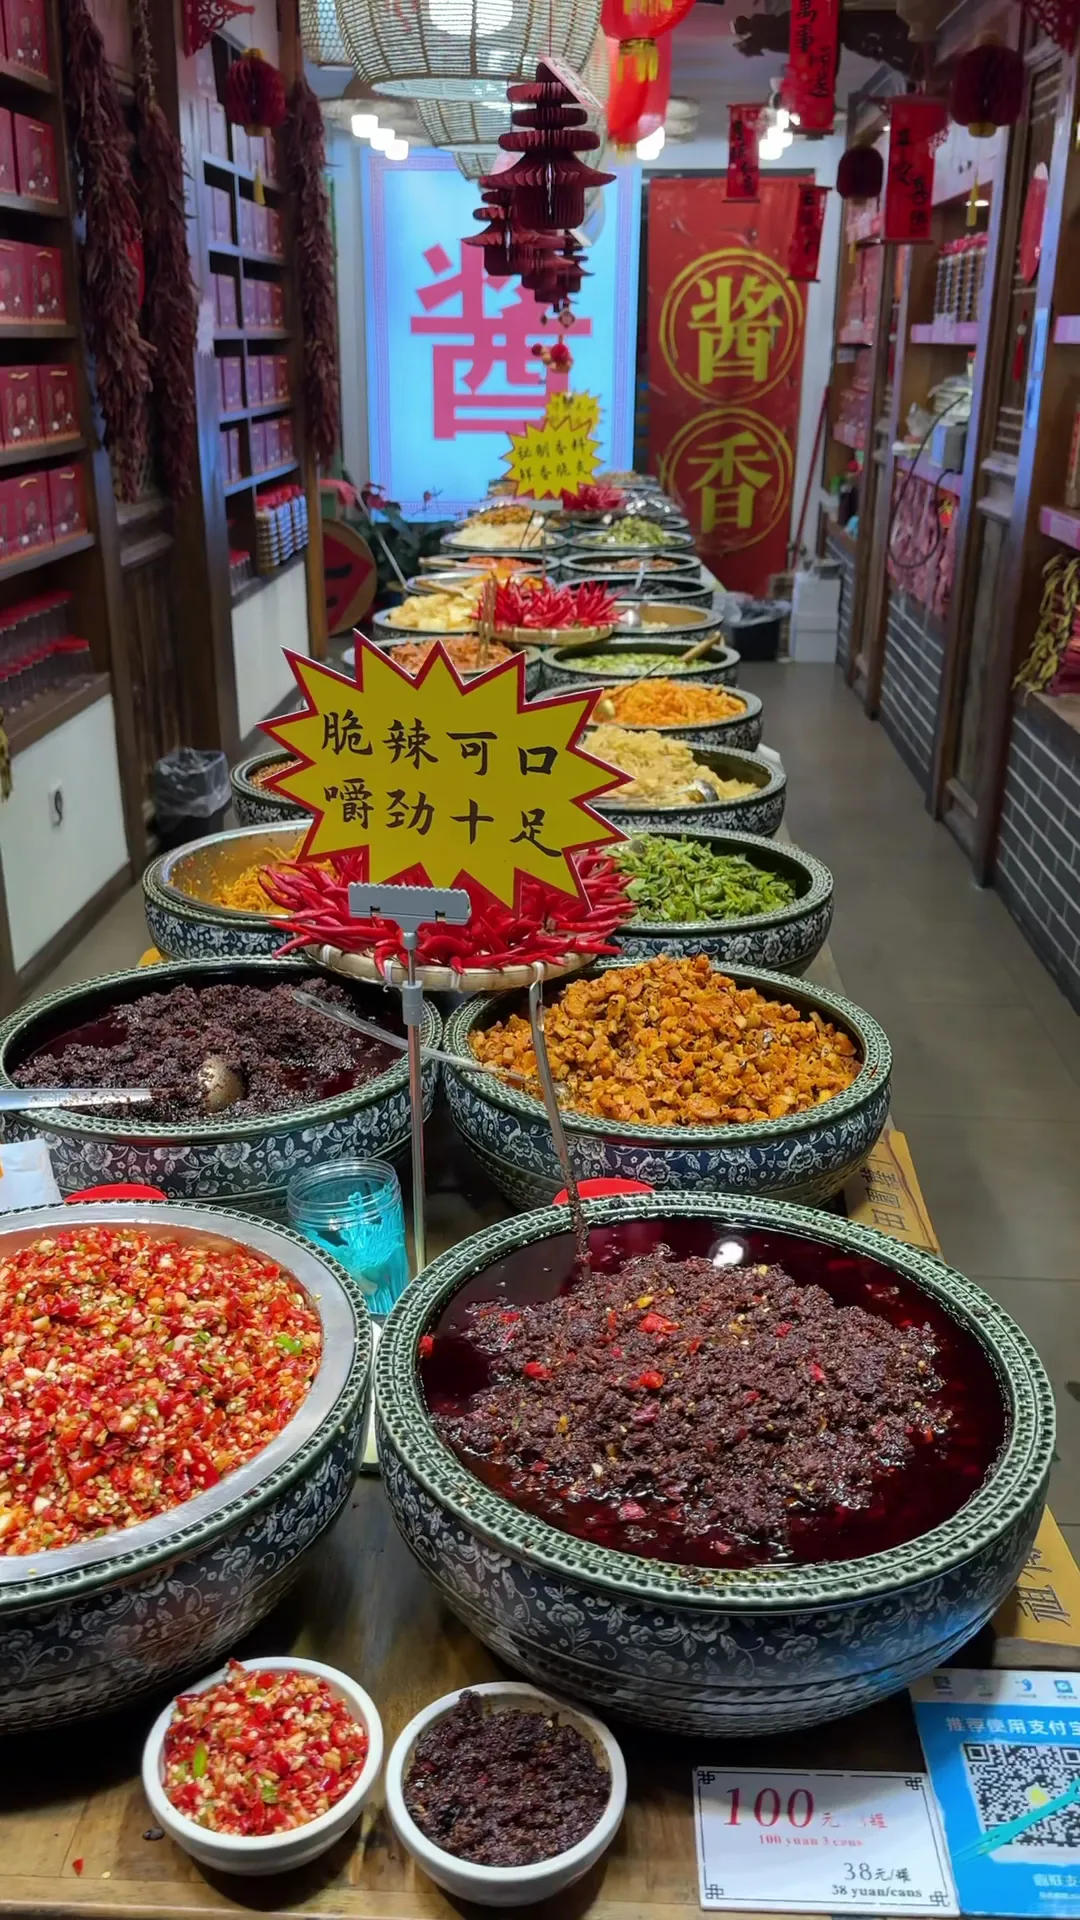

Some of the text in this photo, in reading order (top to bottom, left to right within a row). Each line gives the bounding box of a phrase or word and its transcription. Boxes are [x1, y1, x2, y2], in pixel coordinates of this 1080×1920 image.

[687, 275, 784, 533] 酱香
[321, 709, 558, 776] 脆辣可口
[323, 777, 563, 857] 嚼劲十足
[759, 1834, 781, 1845] 100
[786, 1837, 818, 1848] yuan
[832, 1884, 922, 1899] 38 yuan/cans
